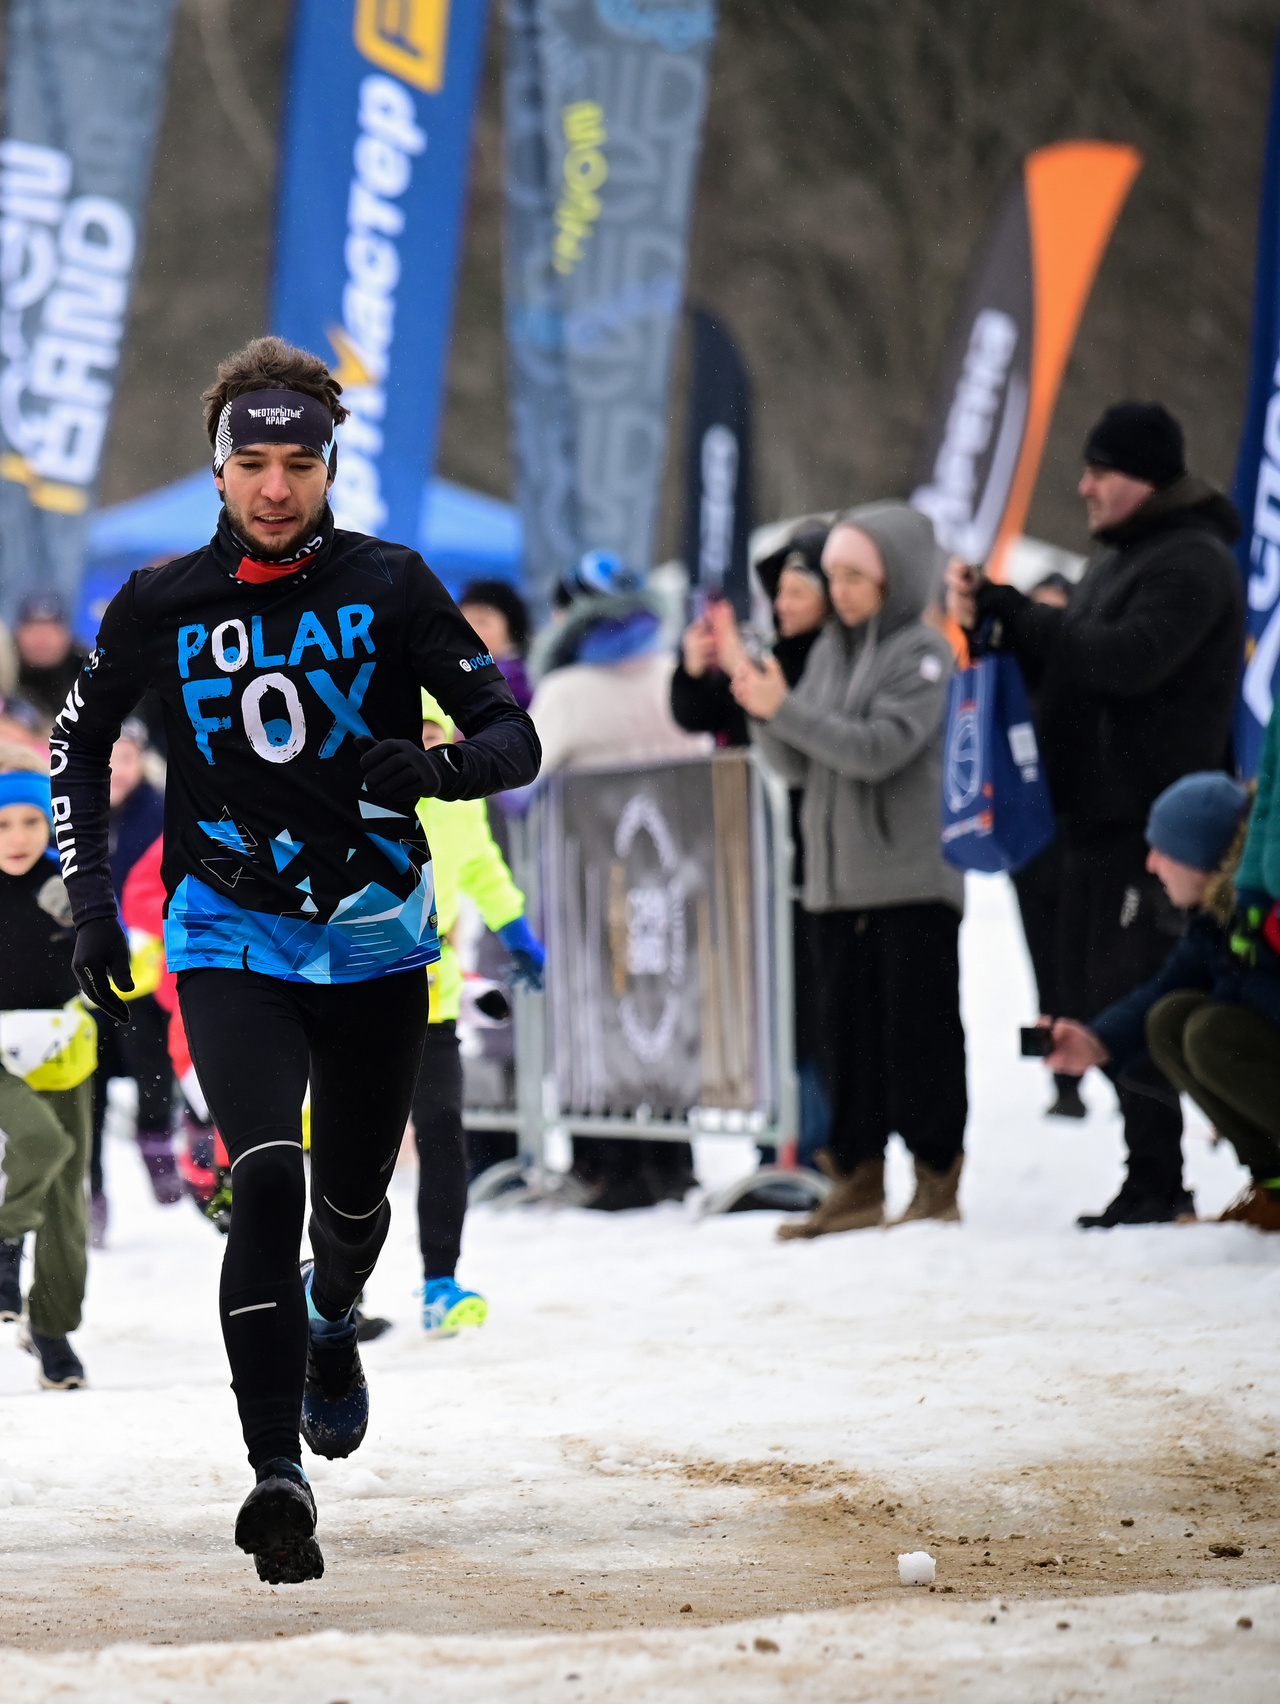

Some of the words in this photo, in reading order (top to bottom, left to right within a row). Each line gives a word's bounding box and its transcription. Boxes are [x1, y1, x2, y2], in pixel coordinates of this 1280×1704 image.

[26, 196, 136, 486] BAND
[177, 604, 376, 678] POLAR
[181, 661, 377, 765] FOX
[51, 795, 78, 880] RUN
[40, 1036, 78, 1070] 41
